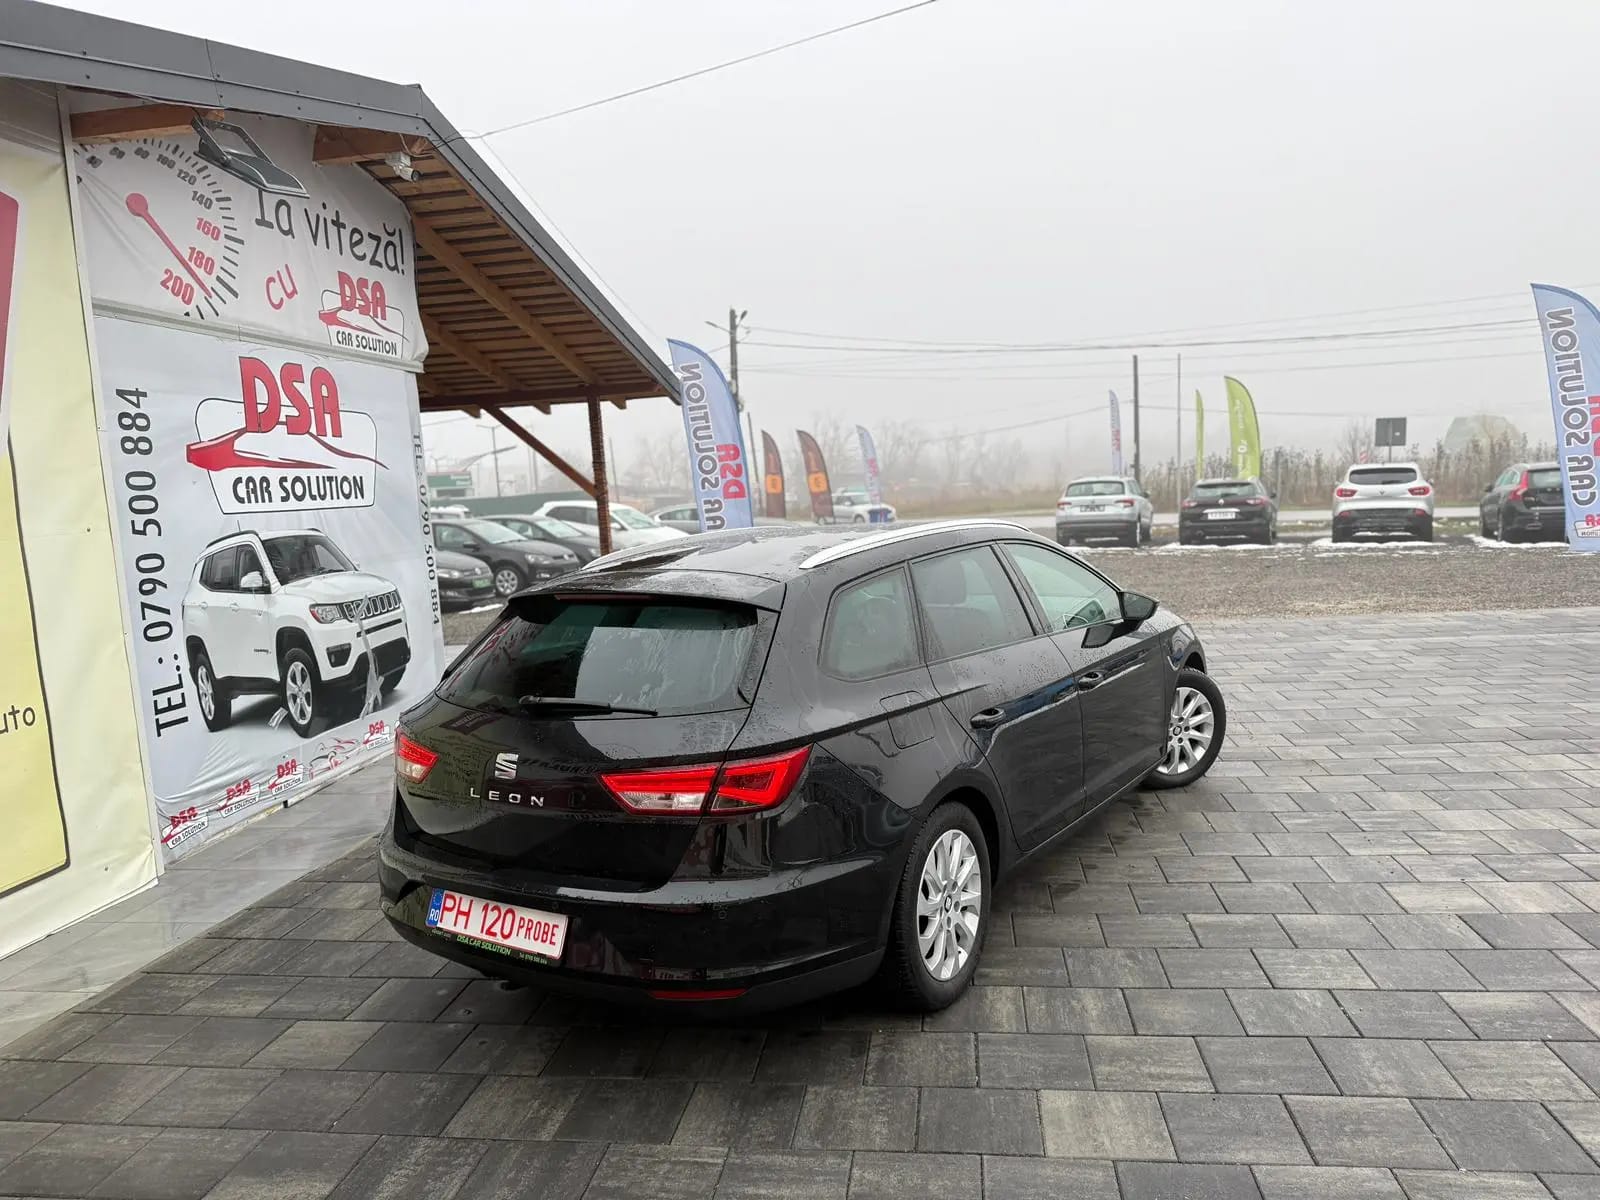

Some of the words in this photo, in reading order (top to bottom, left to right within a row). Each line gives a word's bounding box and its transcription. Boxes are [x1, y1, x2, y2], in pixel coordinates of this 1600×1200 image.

[156, 154, 176, 169] 100
[177, 168, 197, 186] 120
[191, 190, 214, 210] 140
[196, 217, 221, 241] 160
[304, 202, 405, 275] viteză!
[188, 246, 215, 276] 180
[159, 268, 195, 306] 200
[337, 271, 387, 321] DSA
[336, 330, 353, 347] CAR
[355, 336, 397, 355] SOLUTION
[239, 355, 342, 438] DSA
[115, 387, 153, 456] 884
[232, 477, 273, 504] CAR
[279, 476, 365, 503] SOLUTION
[125, 471, 162, 536] 500
[424, 544, 435, 580] 500
[135, 552, 173, 642] 0790
[277, 759, 297, 778] DSA
[226, 778, 251, 800] DSA
[470, 787, 545, 807] LEON
[234, 796, 257, 811] SOLUTION
[171, 835, 181, 845] CAR
[182, 822, 206, 839] SOLUTION
[429, 909, 440, 921] RO
[440, 893, 474, 929] PH
[480, 902, 516, 940] 120
[516, 916, 559, 946] PROBE
[469, 937, 481, 948] CAR
[481, 941, 511, 956] SOLUTION
